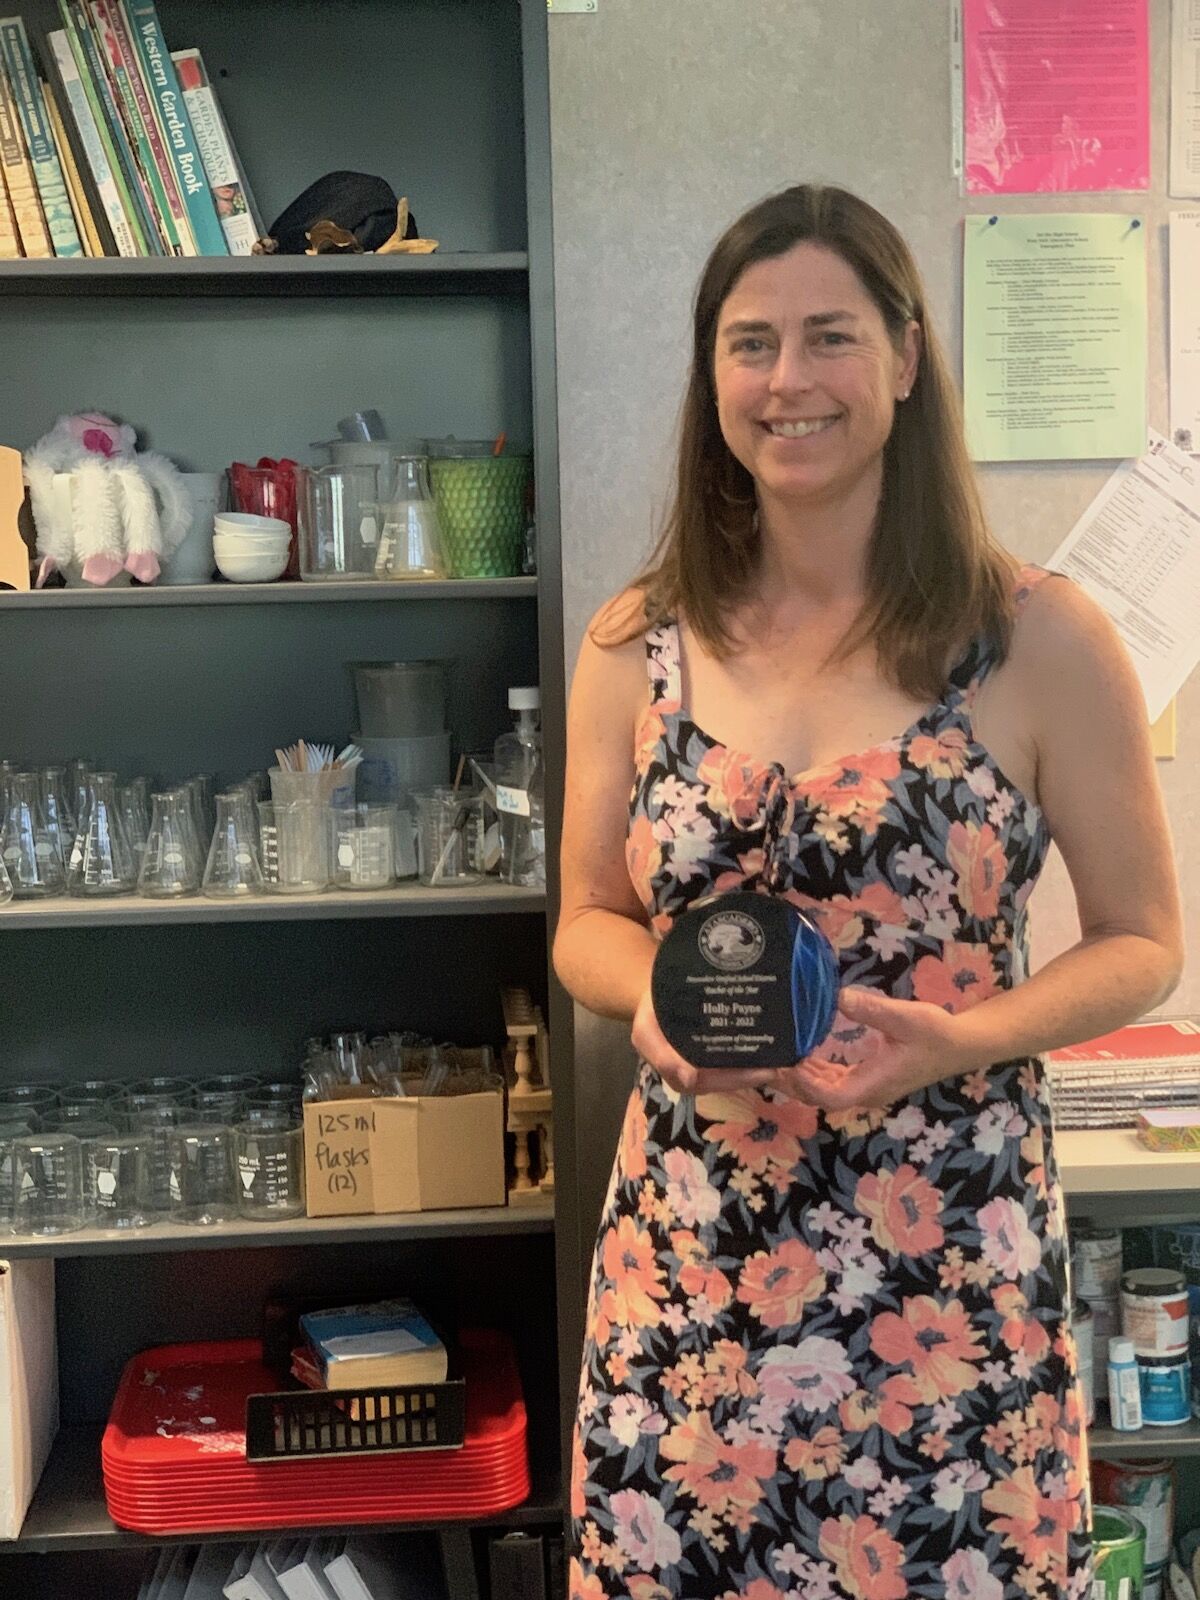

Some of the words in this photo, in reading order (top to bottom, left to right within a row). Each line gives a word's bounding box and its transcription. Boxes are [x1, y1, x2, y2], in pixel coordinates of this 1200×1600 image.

[130, 109, 144, 139] GARDEN
[140, 21, 169, 87] Western
[160, 91, 187, 150] Garden
[178, 152, 200, 195] Book
[189, 108, 219, 182] TECHNIQUES
[194, 89, 215, 136] GARDEN
[209, 139, 229, 182] PLANTS
[703, 1002, 730, 1015] Holly
[732, 1002, 762, 1015] Payne
[328, 1170, 357, 1196] (12)
